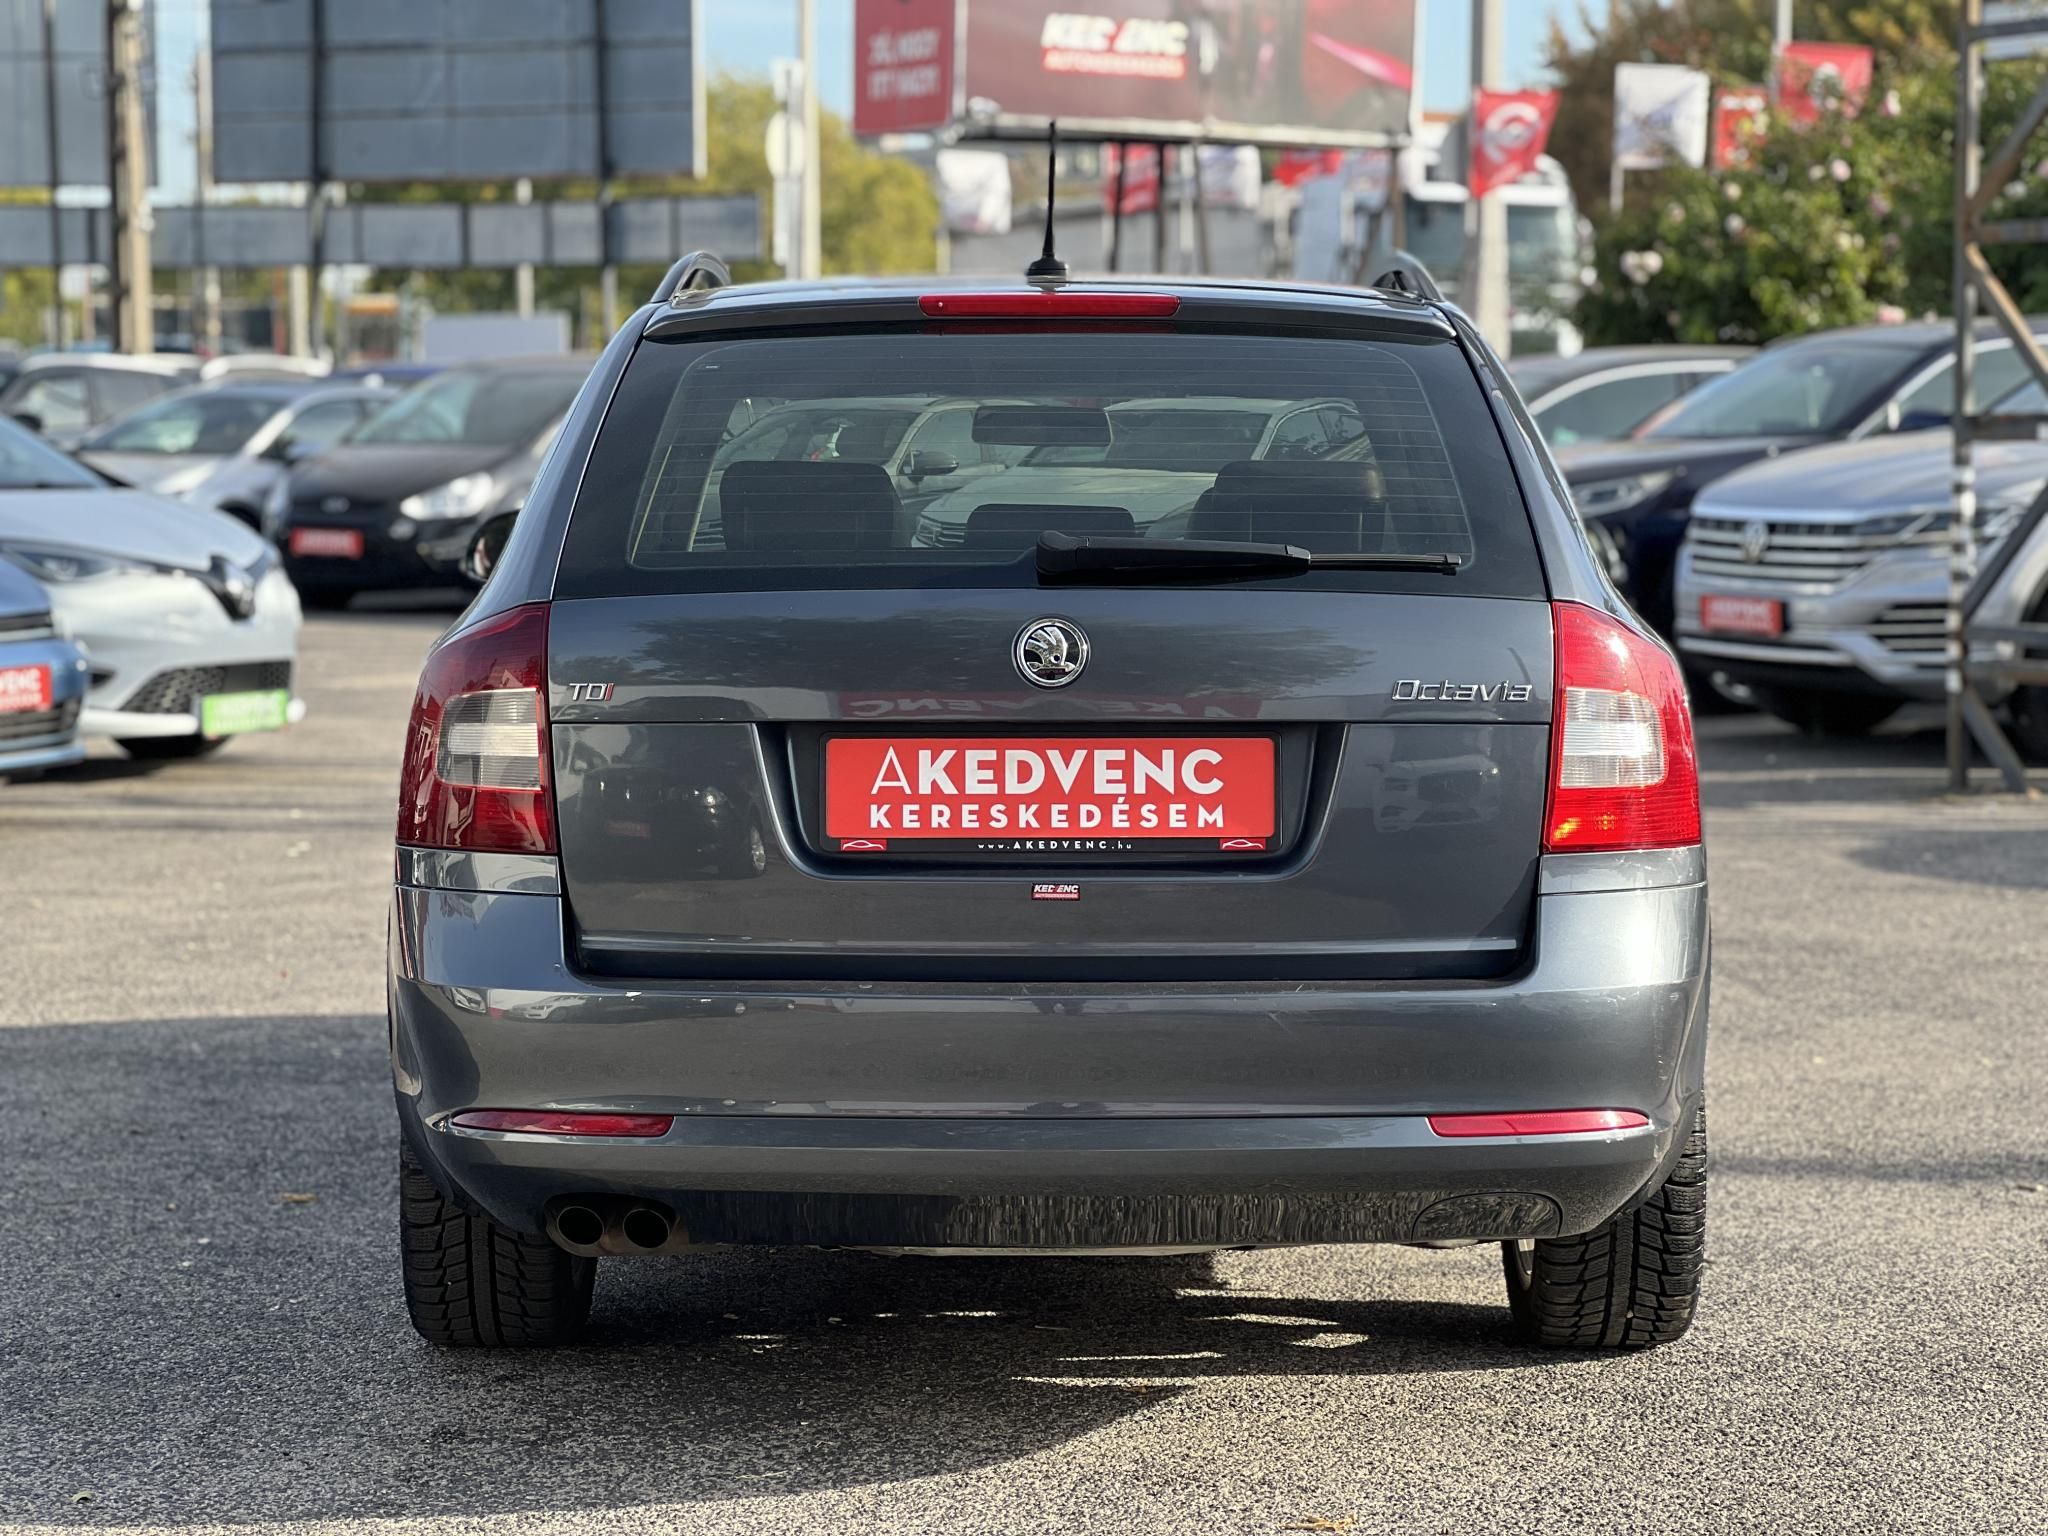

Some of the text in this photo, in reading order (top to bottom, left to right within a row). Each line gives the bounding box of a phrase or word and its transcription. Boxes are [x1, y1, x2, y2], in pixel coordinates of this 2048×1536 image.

[569, 682, 615, 701] TDI
[1392, 680, 1533, 701] Octavia
[870, 745, 1224, 795] AKEDVENC
[870, 796, 1224, 829] KERESKEDÉSEM
[978, 840, 1132, 850] www.AKEDVENC.hu
